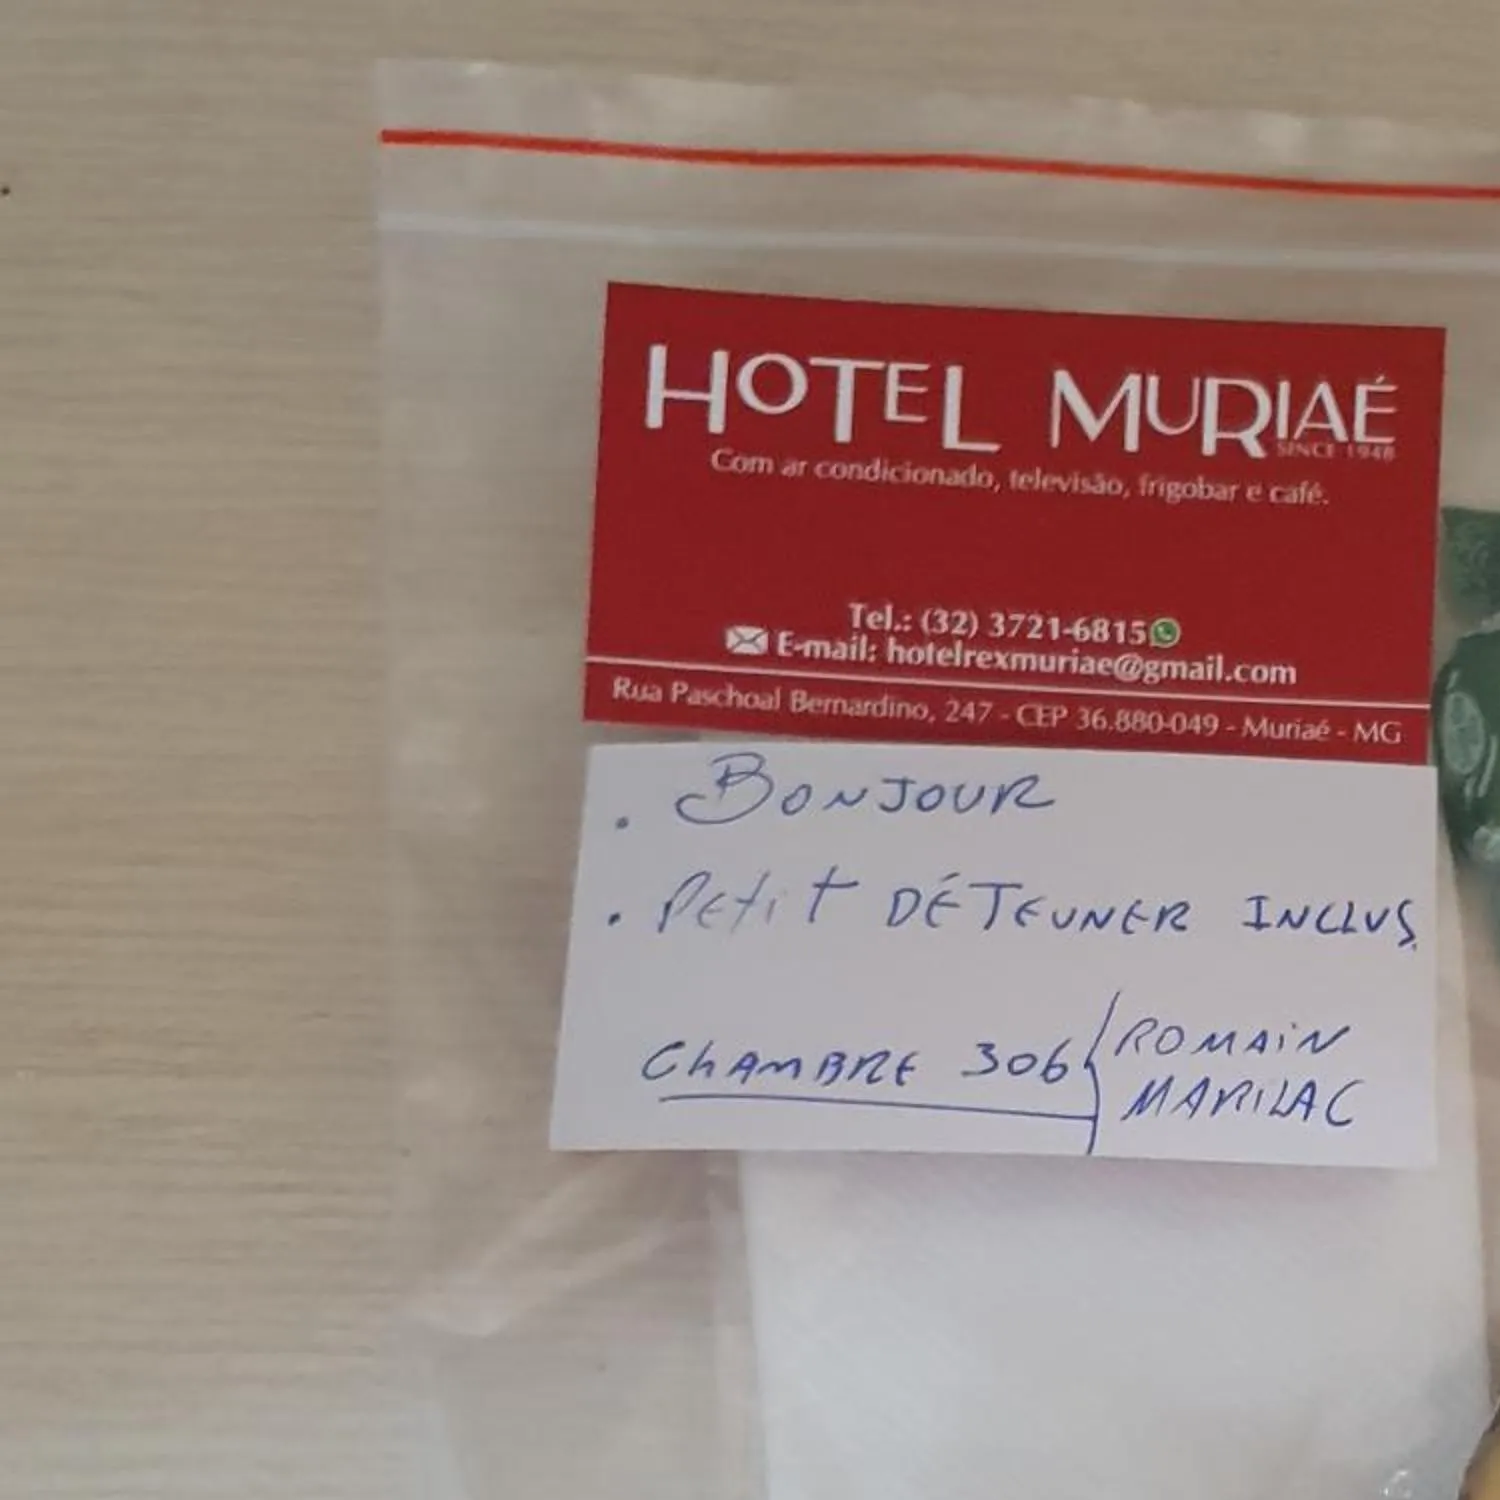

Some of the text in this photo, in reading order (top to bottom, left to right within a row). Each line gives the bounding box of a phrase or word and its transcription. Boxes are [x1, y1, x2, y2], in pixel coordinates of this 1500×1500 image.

[645, 344, 1399, 459] HOTEL MURIAÉ
[710, 447, 1331, 506] Com ar condicionado, televisão, frigobar e café.
[1276, 441, 1335, 459] SINCE
[848, 602, 1148, 646] Tel.: (32) 3721-6815
[776, 629, 1298, 685] E-mail: hotelrexmuriae@gmail.com
[612, 676, 662, 704] Rua
[670, 679, 781, 711] Paschoal
[789, 688, 937, 724] Bernardino,
[945, 698, 993, 725] 247
[1016, 702, 1068, 729] CEP
[1076, 706, 1219, 737] 36.880-049
[1242, 717, 1330, 742] Muriaé
[1353, 720, 1402, 745] MG
[675, 751, 1056, 825] BONJOUR
[961, 1037, 1072, 1084] 306
